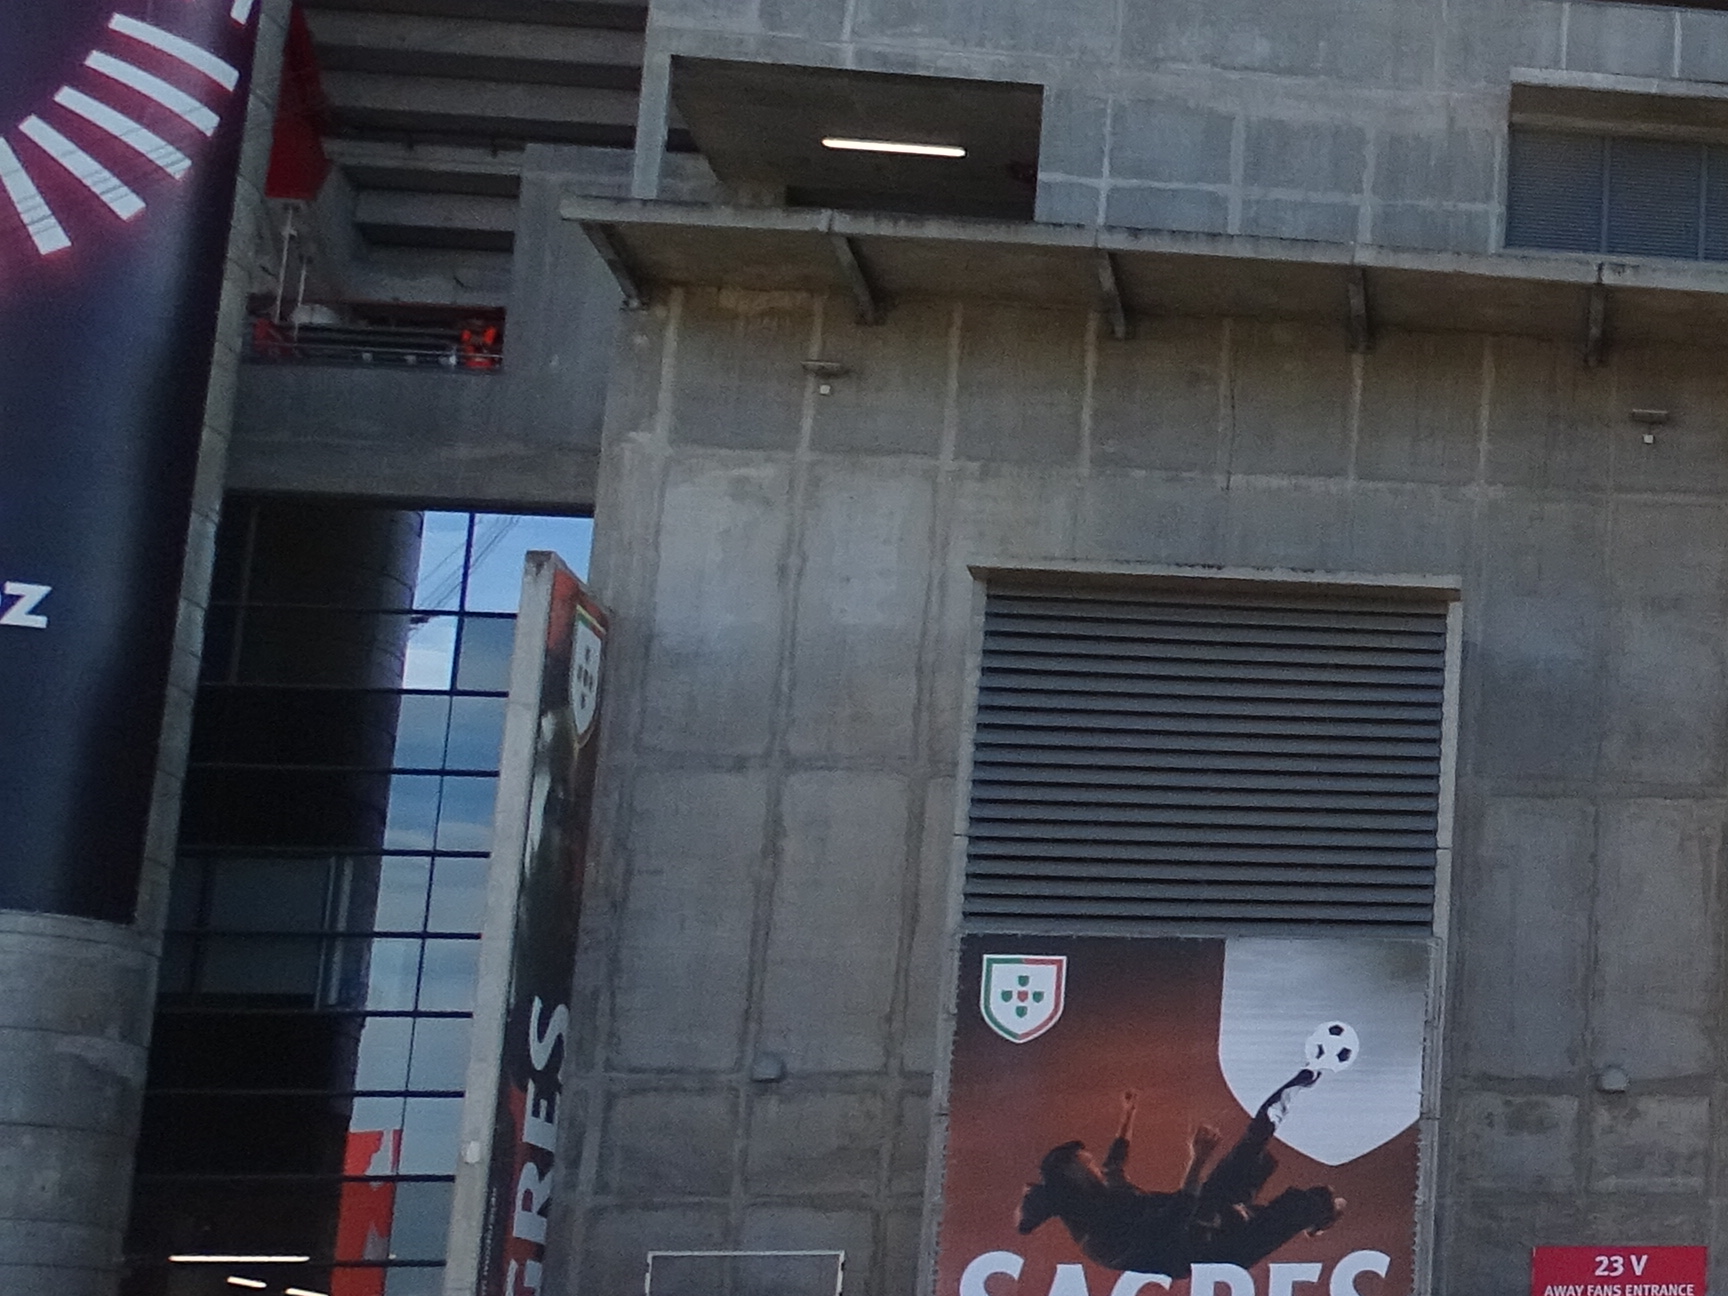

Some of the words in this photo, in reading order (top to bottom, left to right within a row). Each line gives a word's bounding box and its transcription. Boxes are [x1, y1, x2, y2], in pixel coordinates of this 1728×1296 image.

[1594, 1255, 1624, 1277] 23
[1630, 1255, 1648, 1276] V
[1544, 1285, 1584, 1296] AWAY
[1587, 1285, 1621, 1296] FANS
[1625, 1284, 1694, 1296] ENTRANCE
